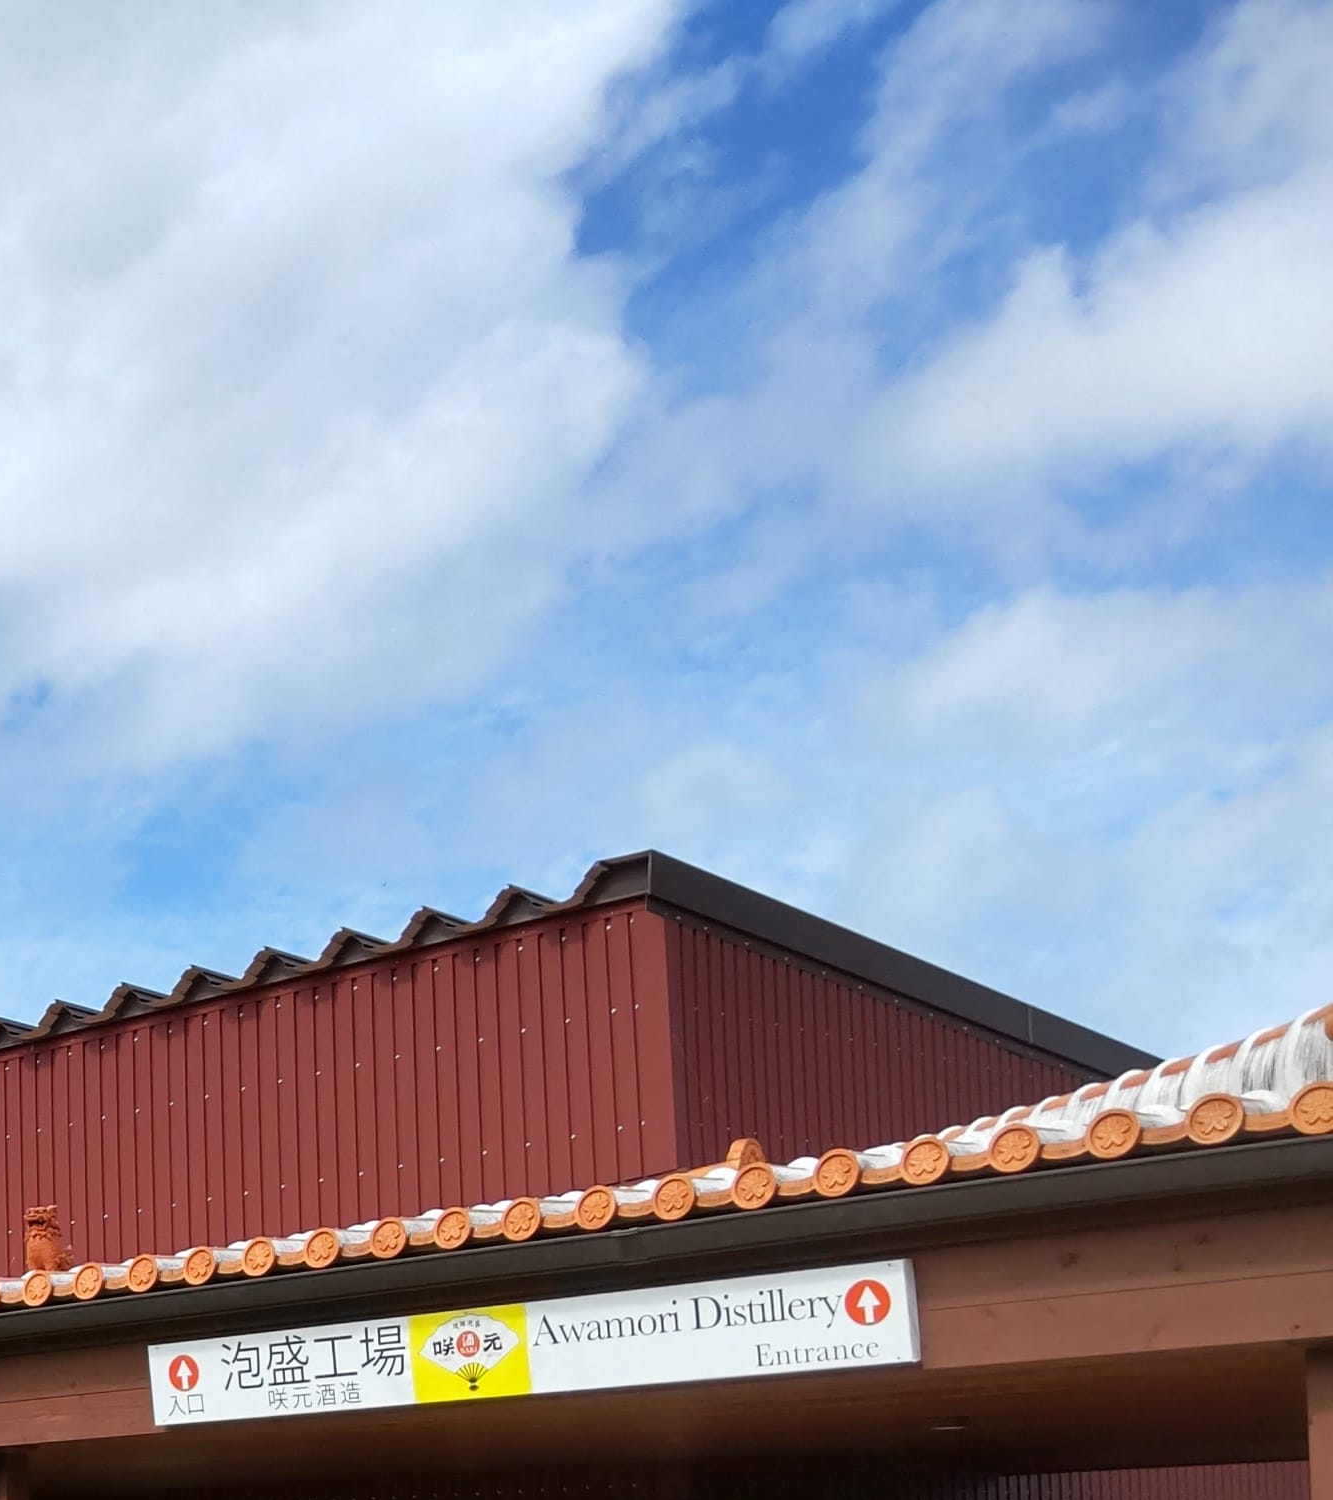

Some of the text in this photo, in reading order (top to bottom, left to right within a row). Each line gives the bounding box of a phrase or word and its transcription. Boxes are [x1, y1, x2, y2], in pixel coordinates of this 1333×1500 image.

[532, 1288, 844, 1347] Awamori Distillery
[220, 1325, 407, 1391] 泡盛工場
[754, 1339, 881, 1368] Entrance
[168, 1393, 206, 1417] 入口
[268, 1382, 363, 1411] 咲元酒造
